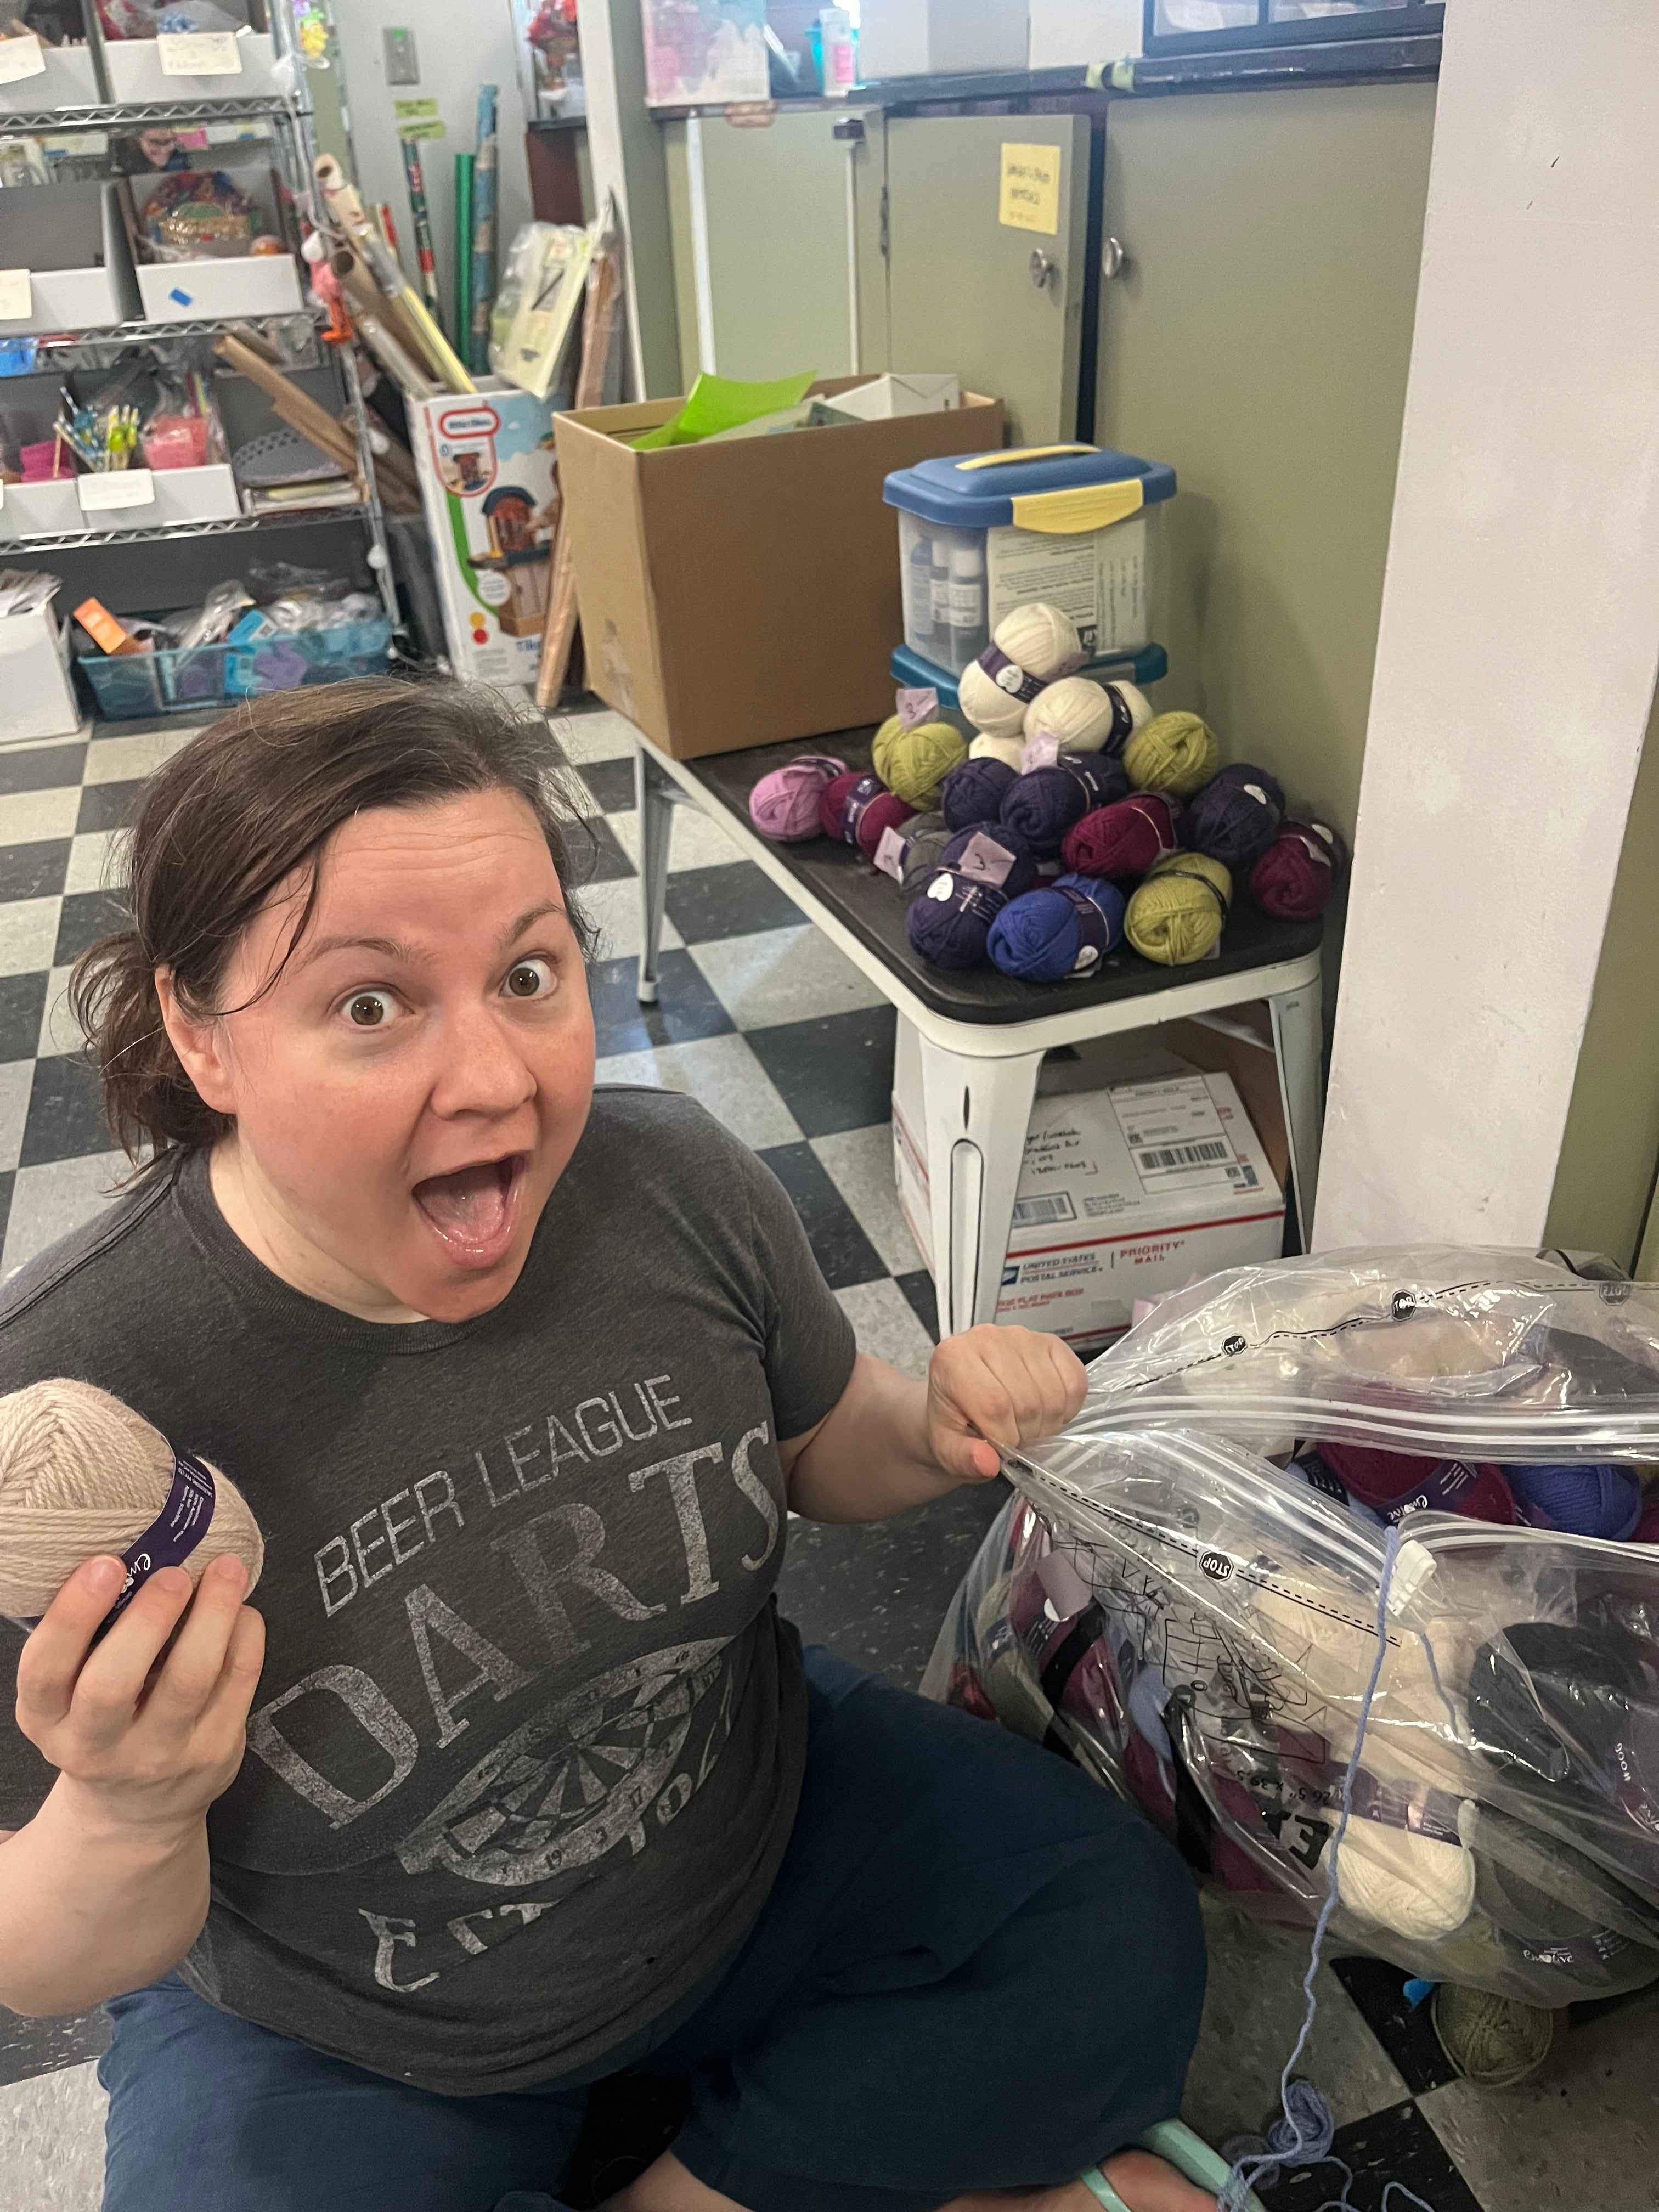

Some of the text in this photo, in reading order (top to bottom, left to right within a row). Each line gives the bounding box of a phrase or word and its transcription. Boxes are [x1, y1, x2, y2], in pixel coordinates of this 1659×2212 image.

[1022, 1251, 1096, 1271] UNITED STATES
[1134, 1254, 1164, 1265] MAIL
[1020, 1273, 1056, 1284] POSTAL
[314, 1470, 465, 1617] BEER
[475, 1375, 693, 1508] LEAGUE
[1203, 1558, 1230, 1577] STOP
[246, 1421, 779, 1830] DARTS
[545, 1849, 562, 1871] 19
